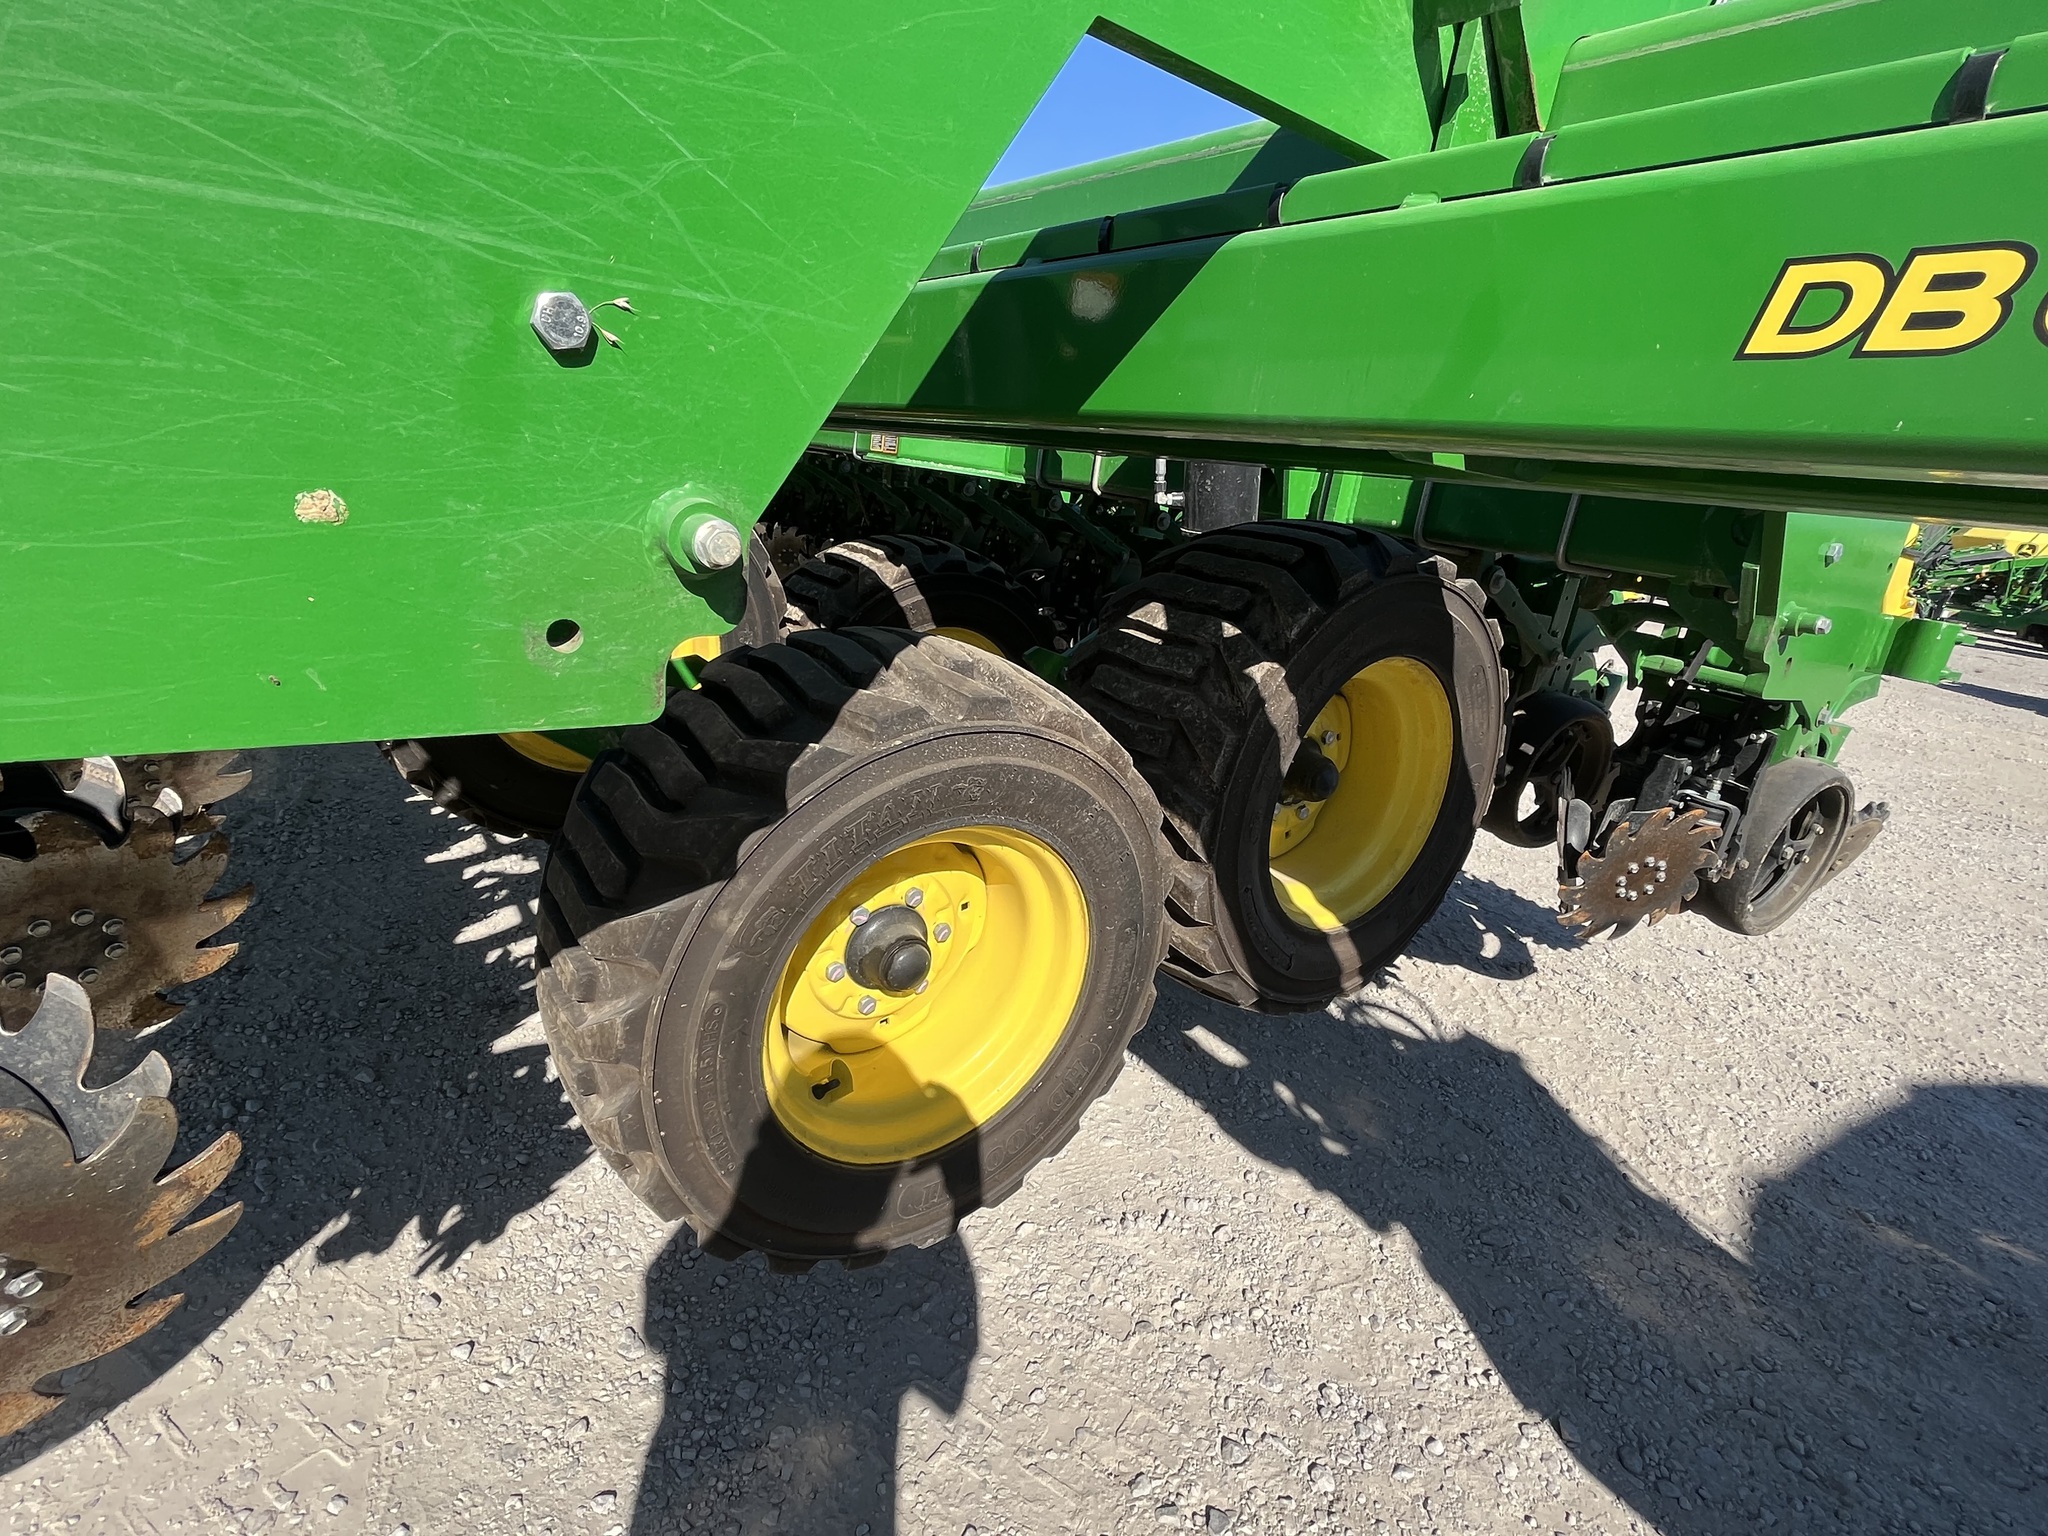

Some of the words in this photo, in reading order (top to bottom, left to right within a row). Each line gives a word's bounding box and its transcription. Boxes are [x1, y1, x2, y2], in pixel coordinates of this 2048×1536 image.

[573, 315, 586, 338] 10.9
[1732, 239, 2039, 361] DB
[787, 782, 943, 900] TITAN
[1049, 1057, 1091, 1113] HD
